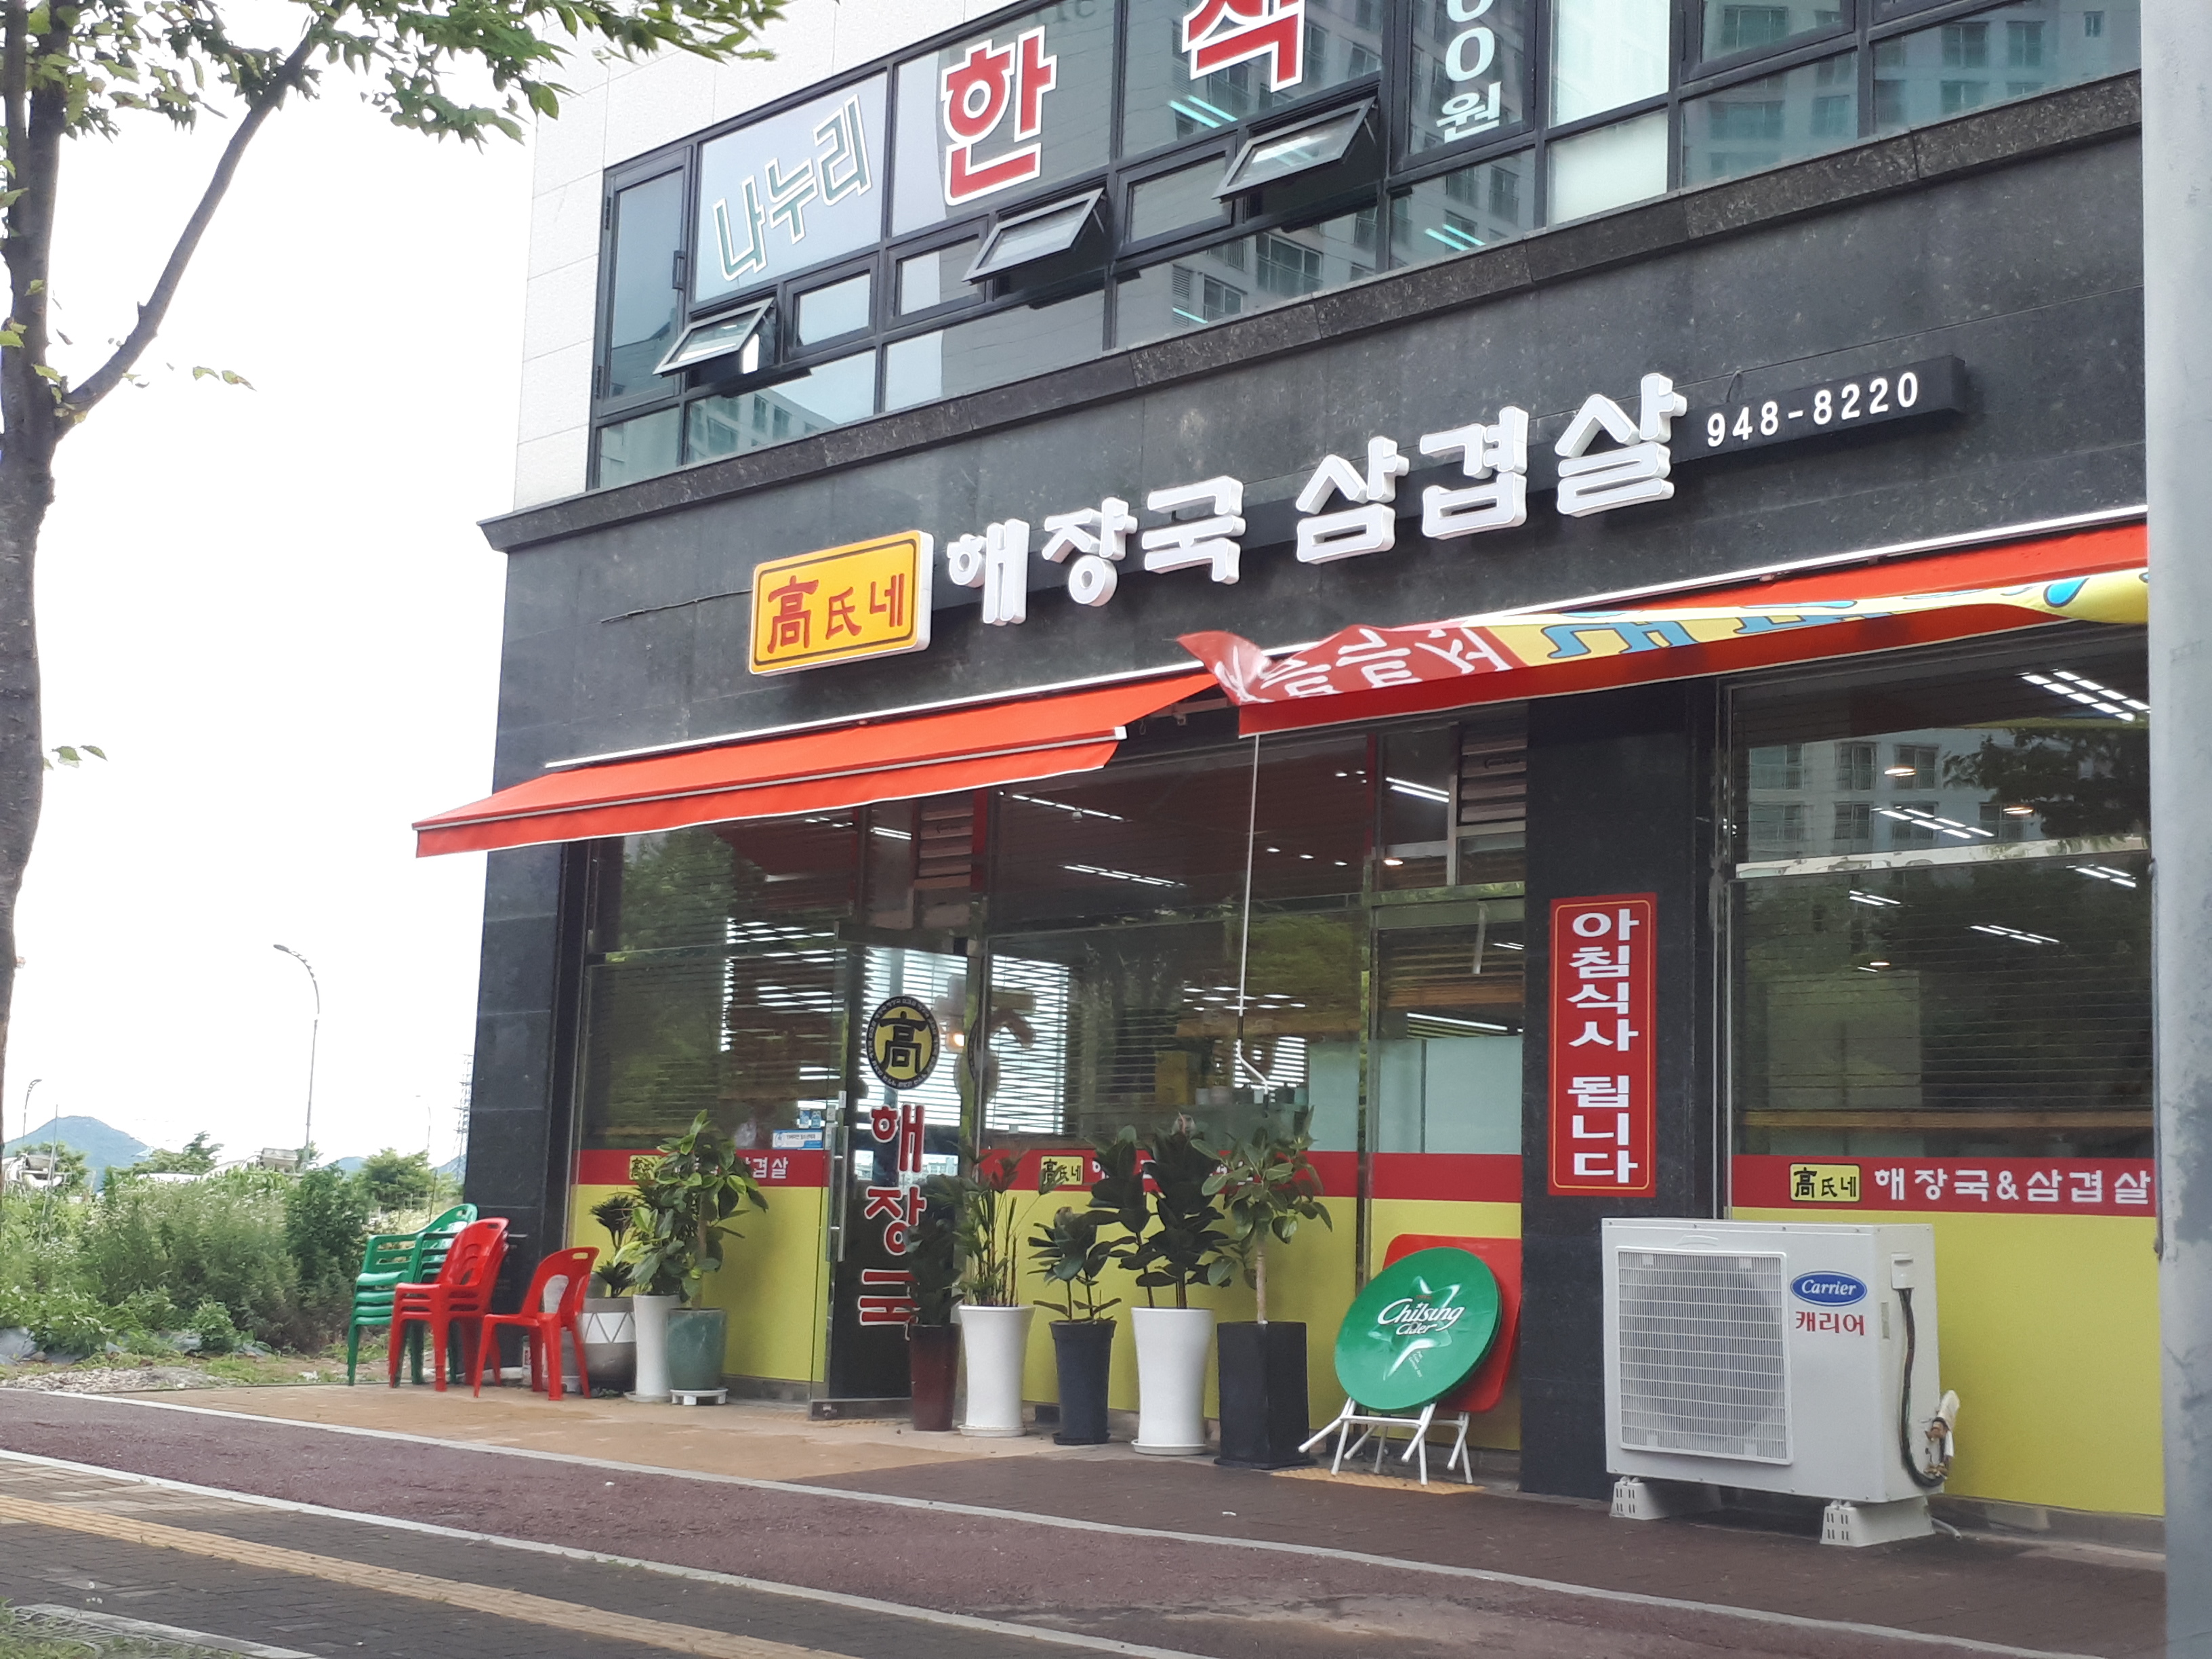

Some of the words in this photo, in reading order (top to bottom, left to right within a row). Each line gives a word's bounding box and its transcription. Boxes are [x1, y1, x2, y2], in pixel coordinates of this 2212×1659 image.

[712, 94, 872, 281] 나누리
[1705, 370, 1919, 448] 948-8220
[767, 573, 905, 654] 高氏네
[947, 475, 1246, 626] 해장국
[1296, 372, 1687, 564] 삼겹살
[1565, 908, 1639, 1051] 아침식사
[1567, 1075, 1639, 1184] 됩니다
[1793, 1166, 1858, 1199] 高氏네
[1377, 1297, 1467, 1332] Chilsung
[1795, 1310, 1865, 1336] 캐리어
[1801, 1278, 1857, 1296] Carrier
